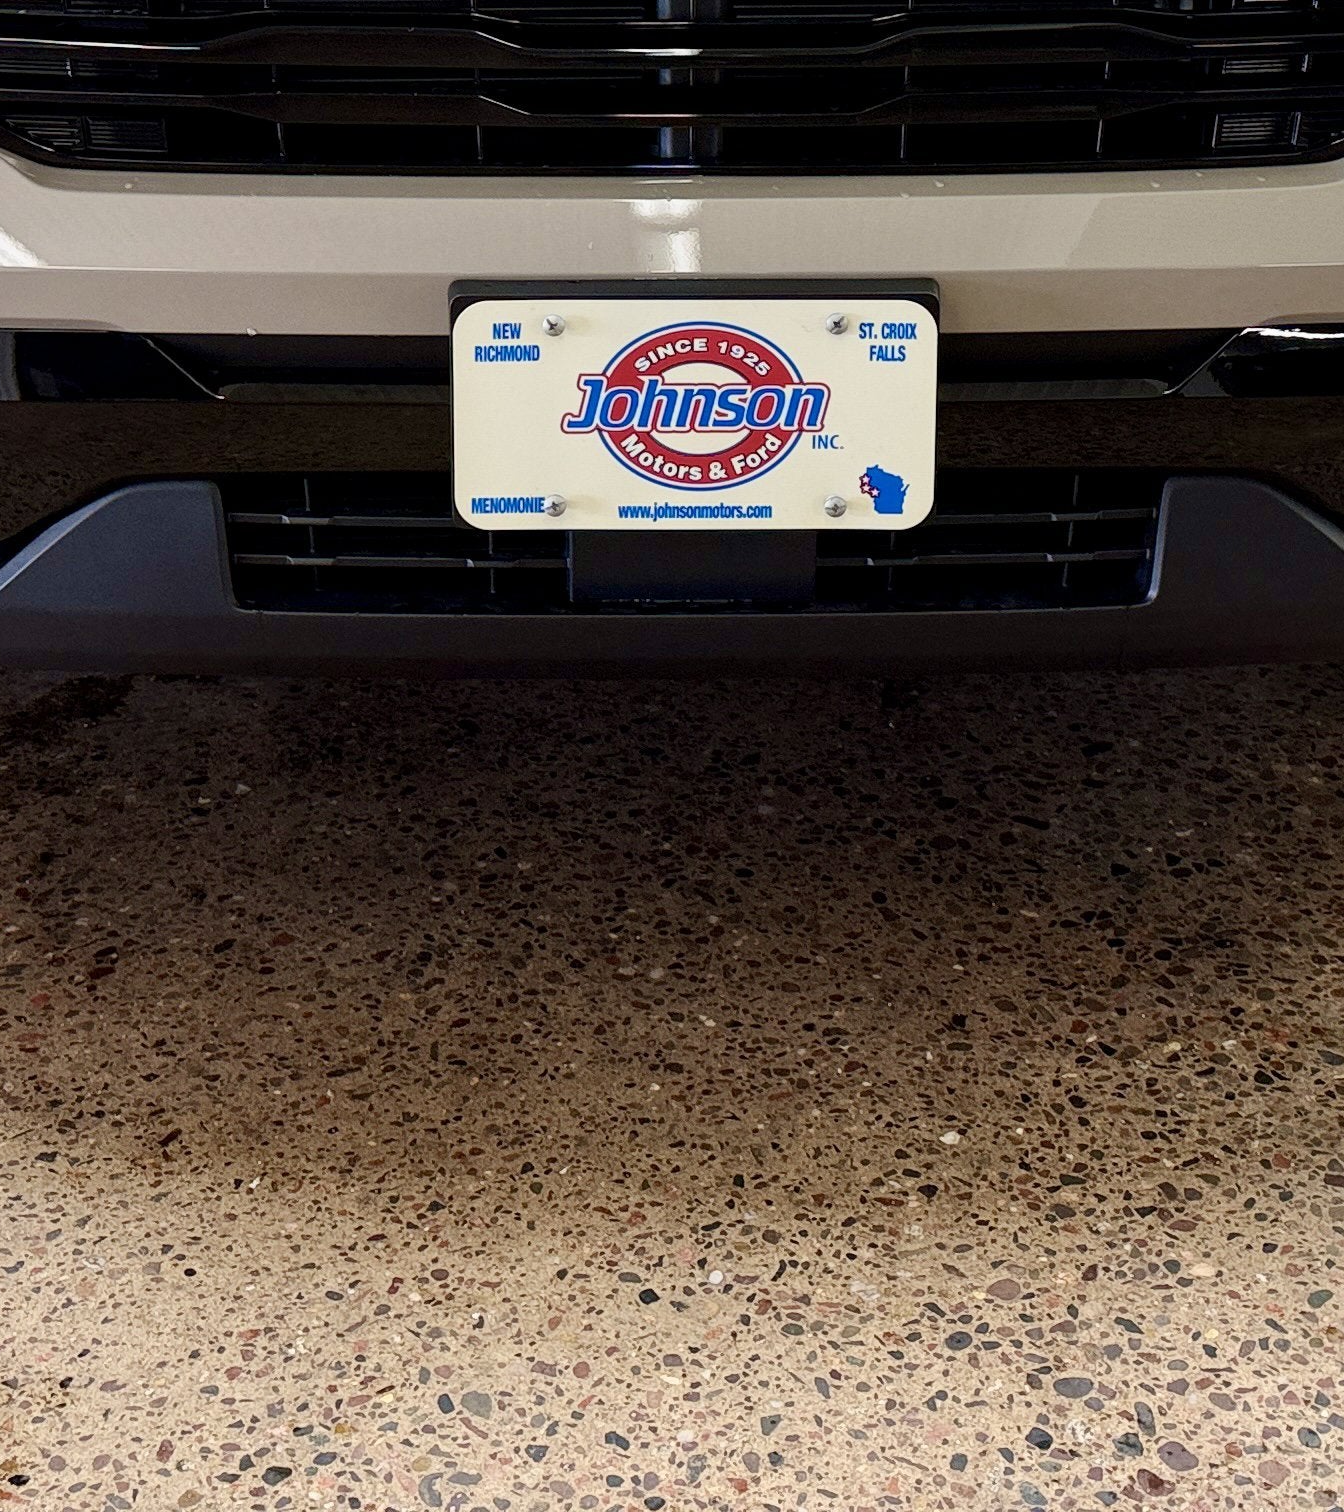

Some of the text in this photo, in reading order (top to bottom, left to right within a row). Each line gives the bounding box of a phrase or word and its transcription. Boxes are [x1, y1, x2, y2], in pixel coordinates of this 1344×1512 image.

[492, 323, 522, 339] NEW
[858, 322, 918, 340] ST. CROIX
[474, 345, 541, 362] RICHMOND
[634, 338, 773, 376] SINCE 1925
[869, 344, 907, 362] FALLS
[565, 377, 827, 429] Johnson
[811, 434, 846, 450] INC.
[619, 432, 783, 481] Motors & Ford
[471, 496, 546, 514] MENOMONIE
[618, 502, 773, 522] www.johnsonmotors.com
